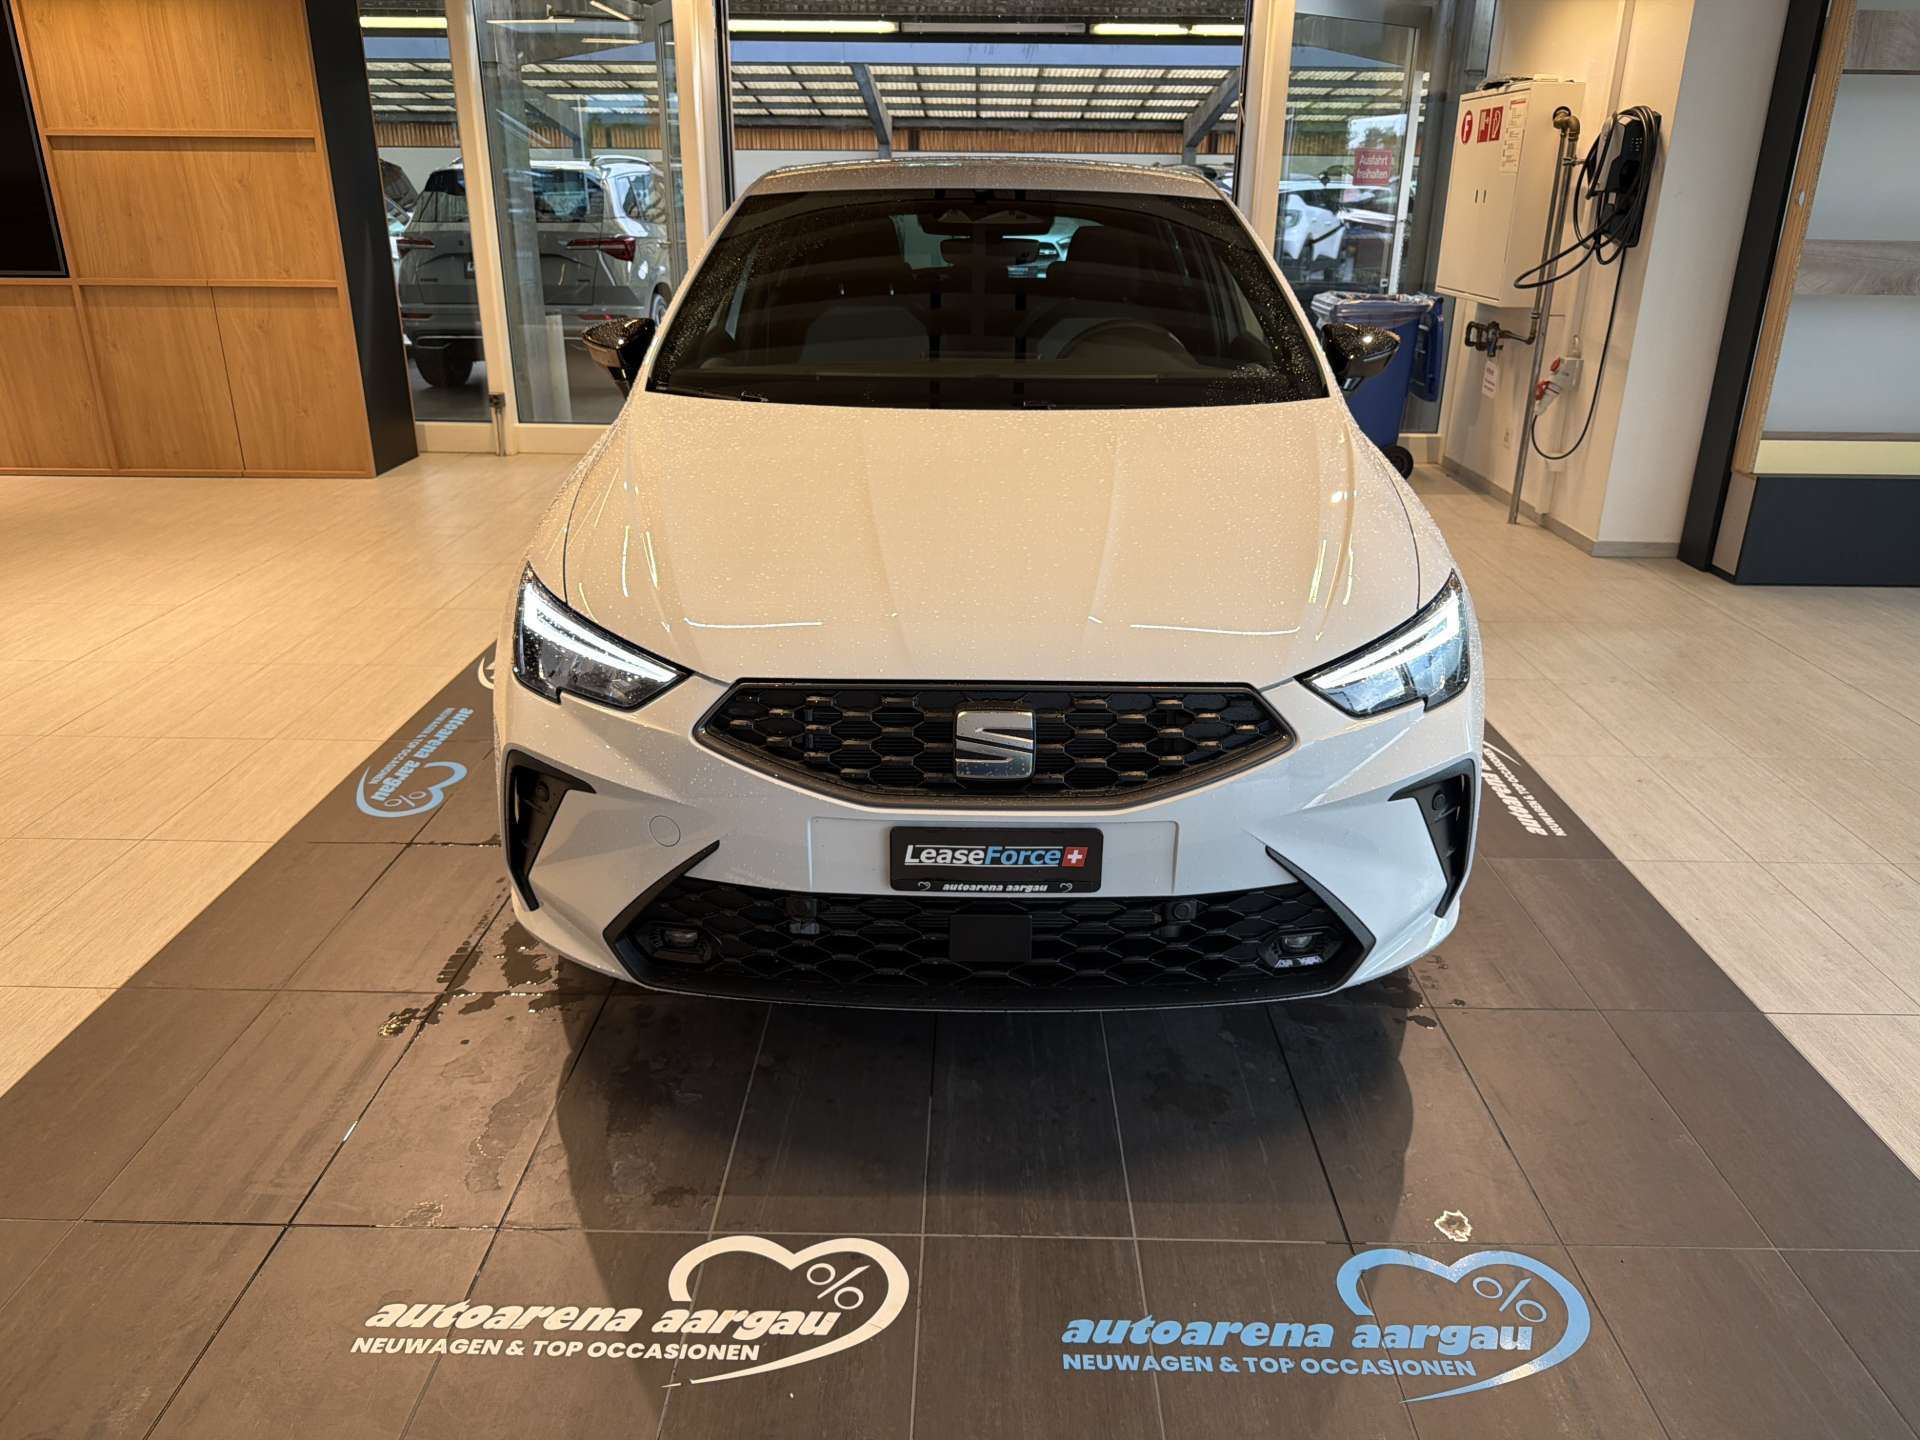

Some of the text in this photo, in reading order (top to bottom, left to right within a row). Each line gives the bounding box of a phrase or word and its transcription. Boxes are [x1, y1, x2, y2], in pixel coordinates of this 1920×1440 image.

[904, 844, 1061, 866] LeaseForce
[942, 881, 1048, 893] autoarena aargau
[365, 1299, 841, 1341] autoarena aargau
[1061, 1314, 1533, 1356] autoarena aargau
[350, 1337, 760, 1361] NEUWAGEN & TOP OCCASIONEN
[1062, 1353, 1477, 1377] NEUWAGEN & TOP OCCASIONEN
